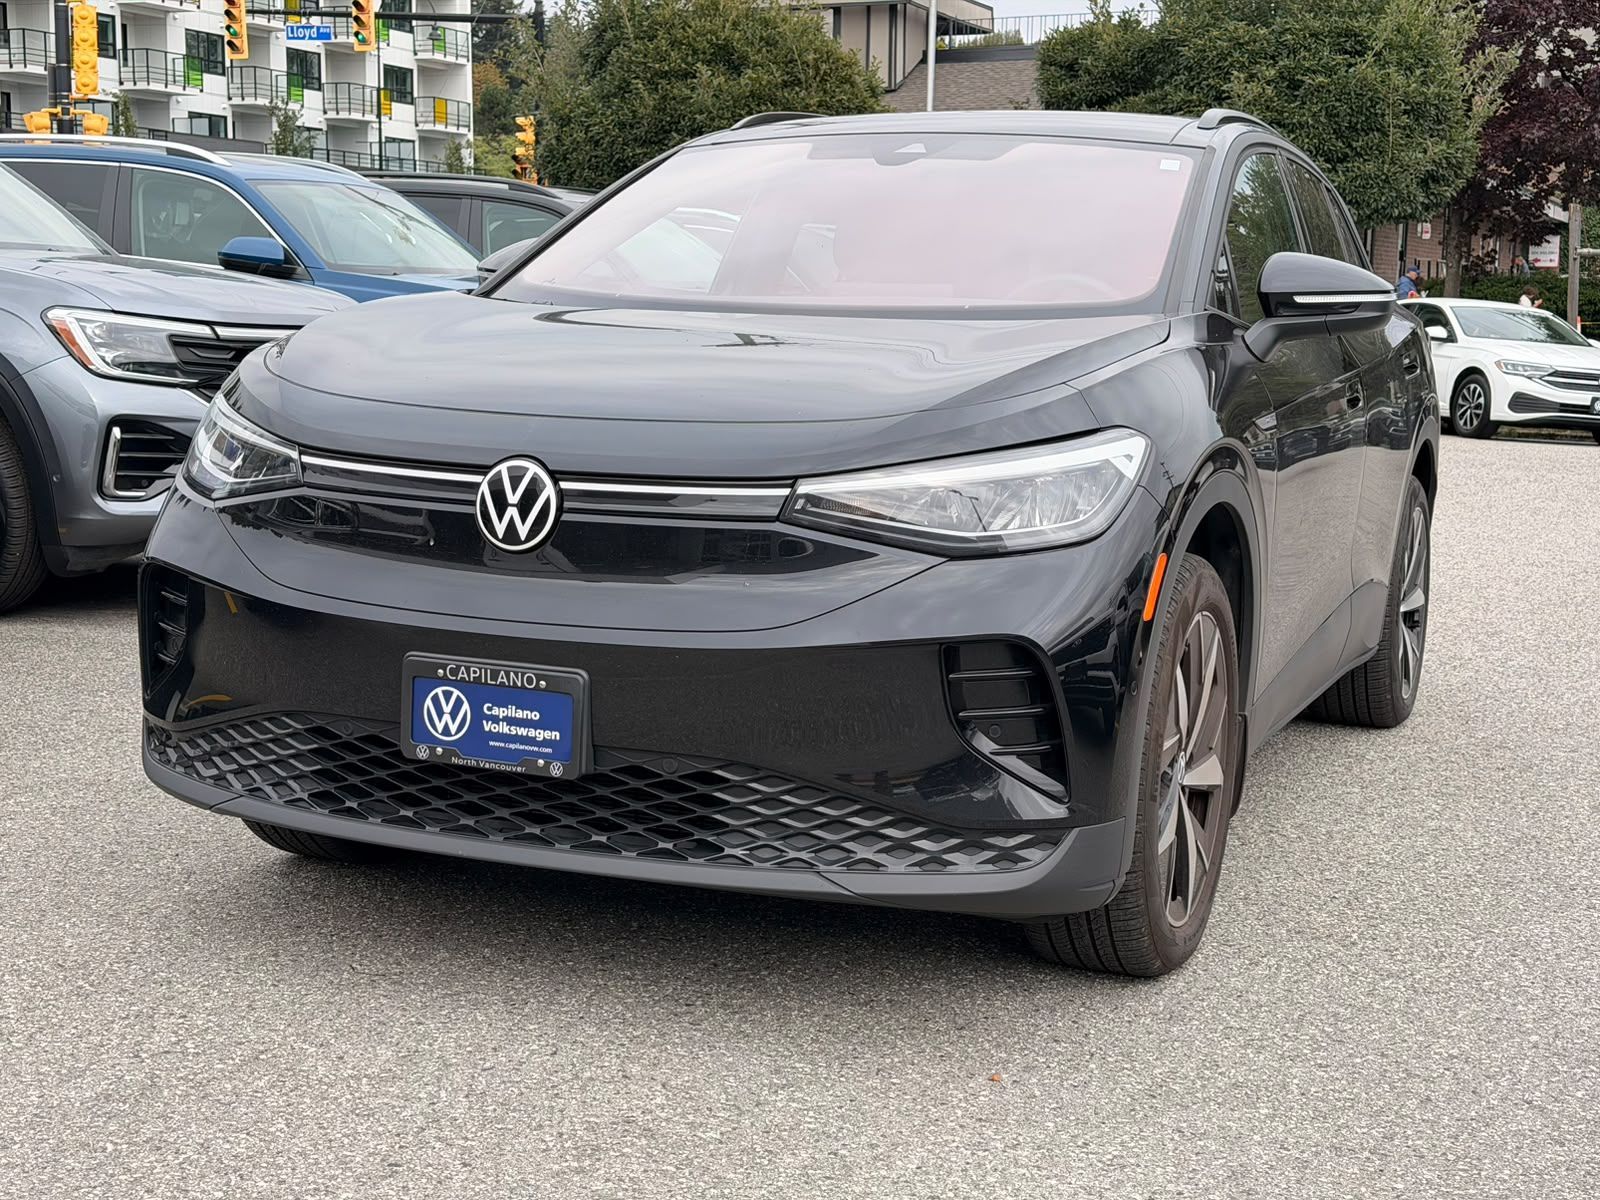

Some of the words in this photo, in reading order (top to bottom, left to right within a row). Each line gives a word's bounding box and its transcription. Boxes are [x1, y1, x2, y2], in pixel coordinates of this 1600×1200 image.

[287, 26, 317, 40] Lloyd
[477, 459, 556, 551] VW
[446, 664, 537, 689] CAPILANO
[424, 686, 471, 741] VW
[482, 703, 541, 721] Capilano
[482, 719, 561, 741] Volkswagen
[488, 739, 553, 754] www.capilanovw.com
[451, 756, 477, 767] North
[478, 760, 526, 773] Vancouver
